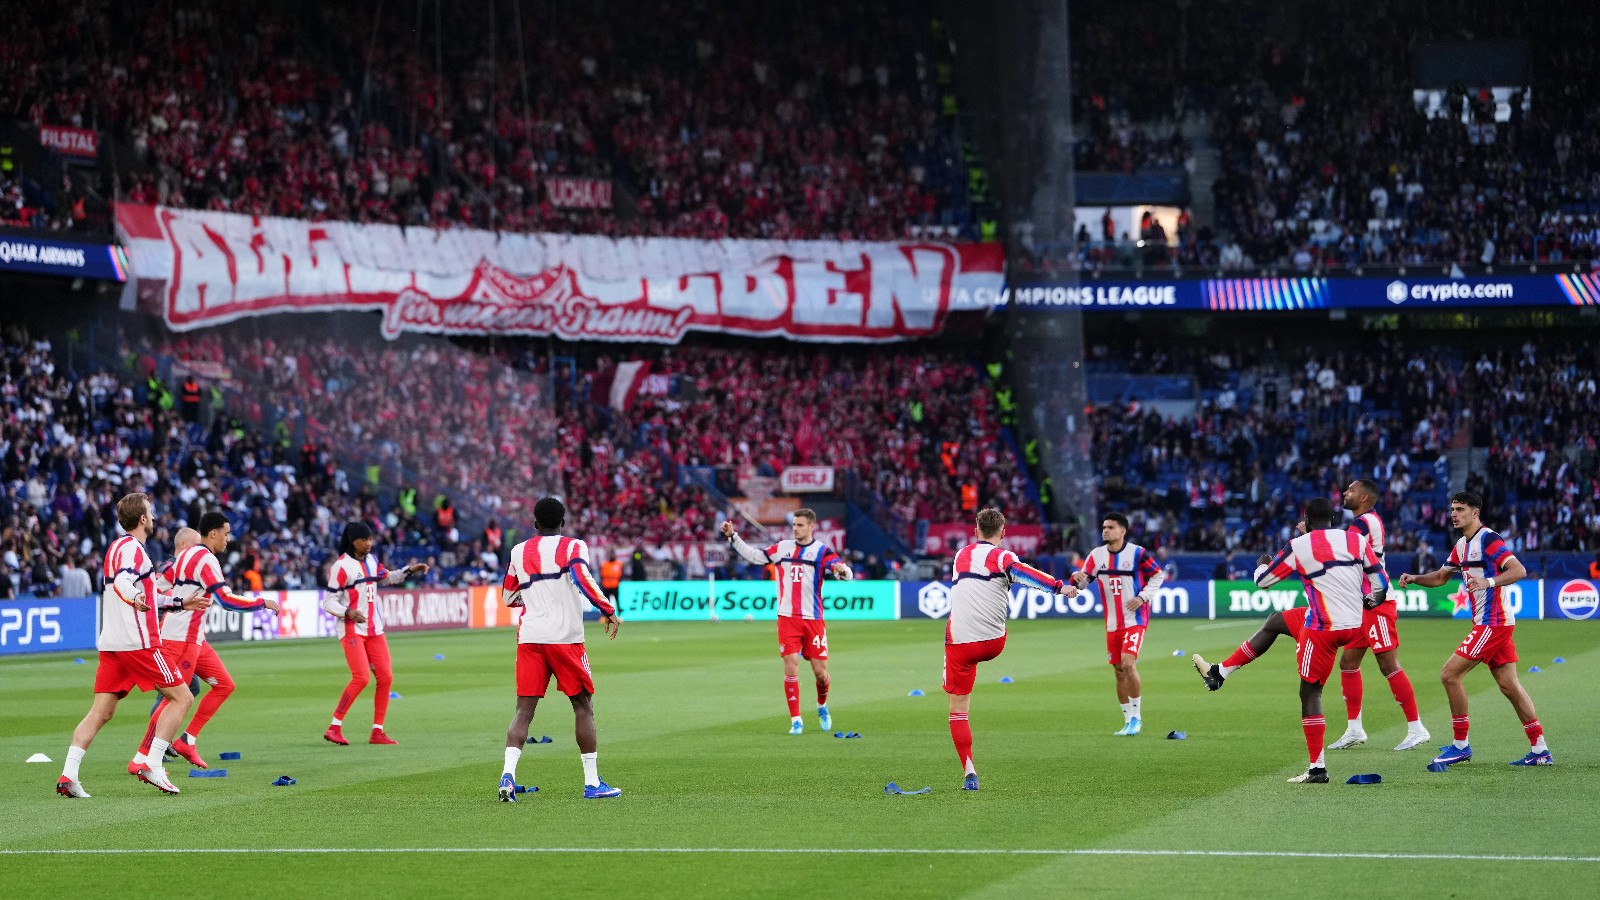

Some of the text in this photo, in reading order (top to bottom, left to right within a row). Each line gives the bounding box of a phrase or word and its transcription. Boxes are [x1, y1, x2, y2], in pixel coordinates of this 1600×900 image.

[41, 129, 95, 152] FILSTAL
[0, 241, 37, 263] QATAR
[1097, 286, 1176, 305] LEAGUE
[1411, 281, 1513, 301] crypto.com
[1229, 590, 1300, 612] now
[1, 606, 60, 646] PS5
